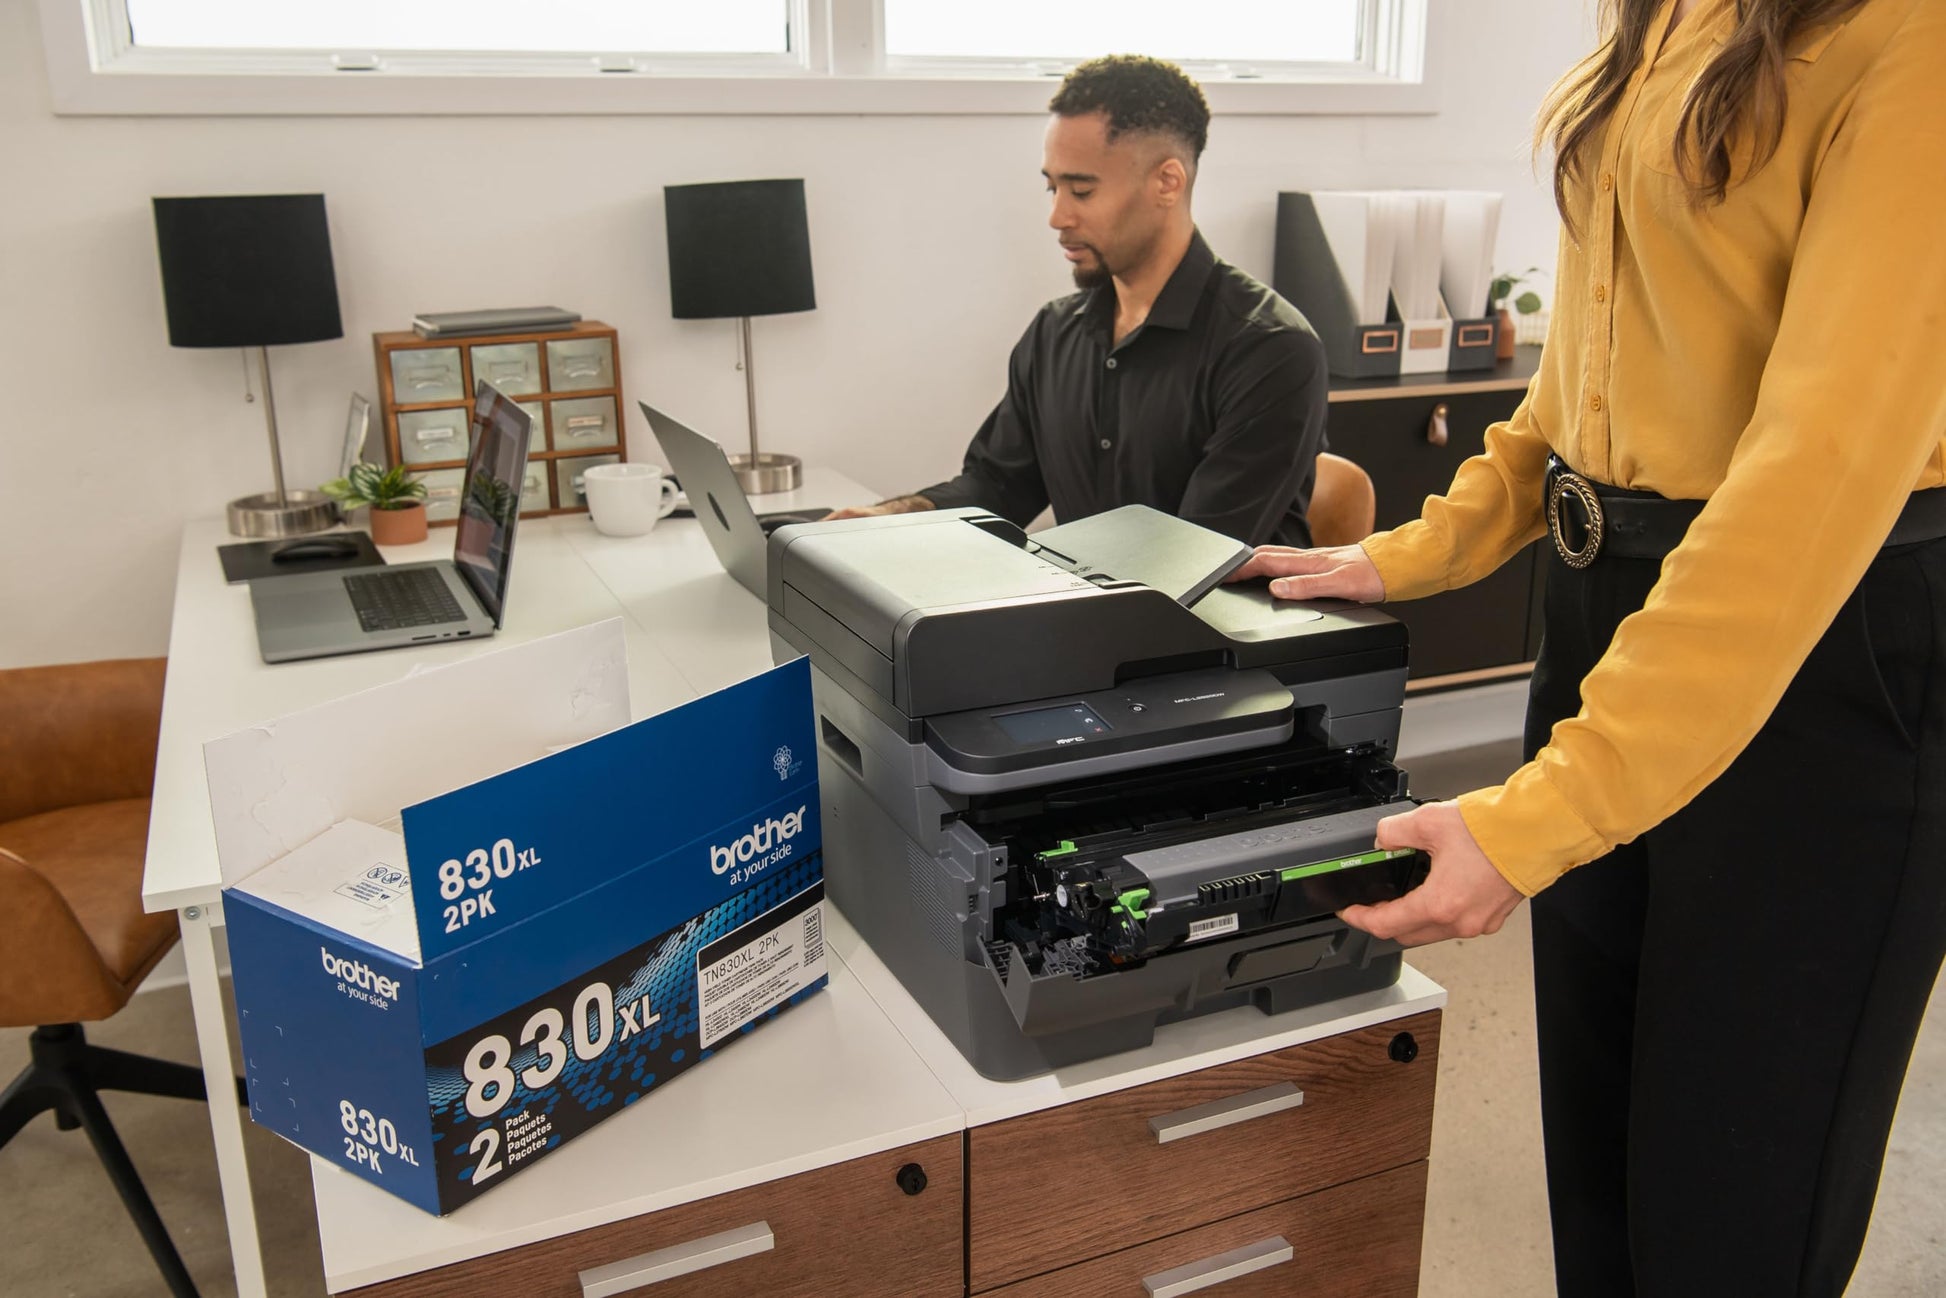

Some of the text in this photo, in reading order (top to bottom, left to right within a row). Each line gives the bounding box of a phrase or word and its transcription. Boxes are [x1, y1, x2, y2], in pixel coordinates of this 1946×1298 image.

[710, 804, 806, 875] brother
[438, 838, 542, 900] 830XL
[730, 844, 792, 886] at your side
[443, 889, 497, 934] 2PK
[321, 946, 400, 1002] brother
[703, 947, 755, 986] TN830XL
[758, 932, 780, 955] 2PK
[337, 981, 389, 1011] at your side
[463, 981, 661, 1118] 830XL
[339, 1099, 419, 1167] 830XL
[505, 1109, 530, 1130] Pack
[506, 1114, 546, 1142] Paquets
[507, 1122, 552, 1154] Paquetes
[343, 1137, 383, 1175] 2PK
[469, 1128, 503, 1186] 2
[508, 1137, 547, 1165] Pacotes
